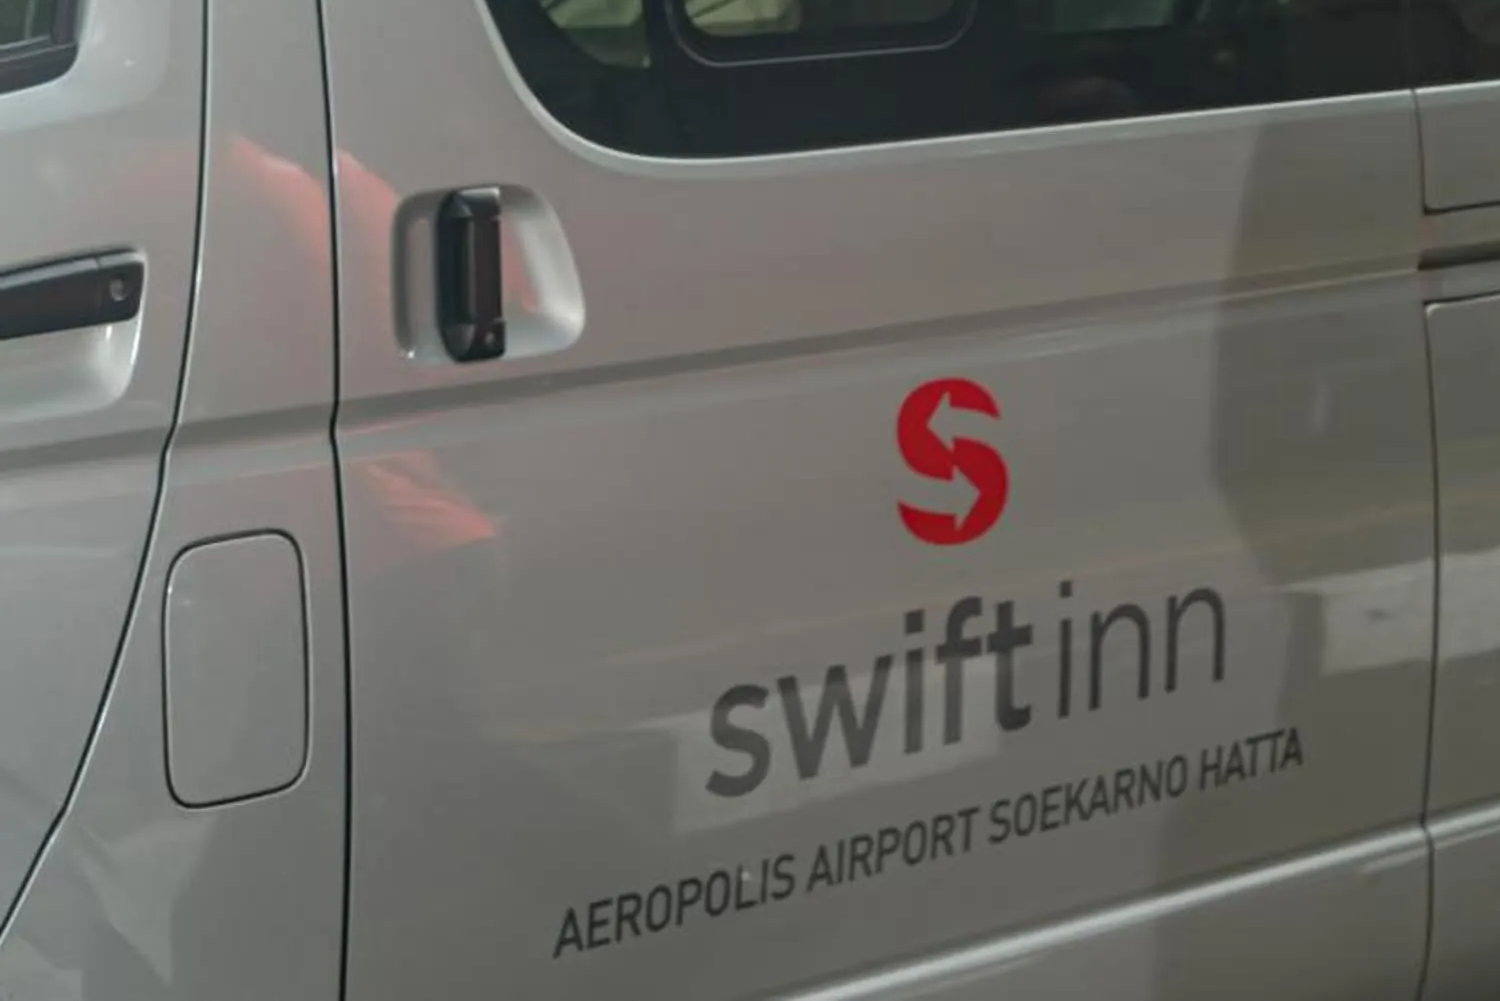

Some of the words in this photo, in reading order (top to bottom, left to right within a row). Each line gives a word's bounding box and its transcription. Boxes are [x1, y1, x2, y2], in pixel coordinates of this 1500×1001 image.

[552, 853, 796, 959] AEROPOLIS
[806, 806, 980, 892] AIRPORT
[987, 754, 1188, 845] SOEKARNO
[1198, 728, 1303, 790] HATTA
